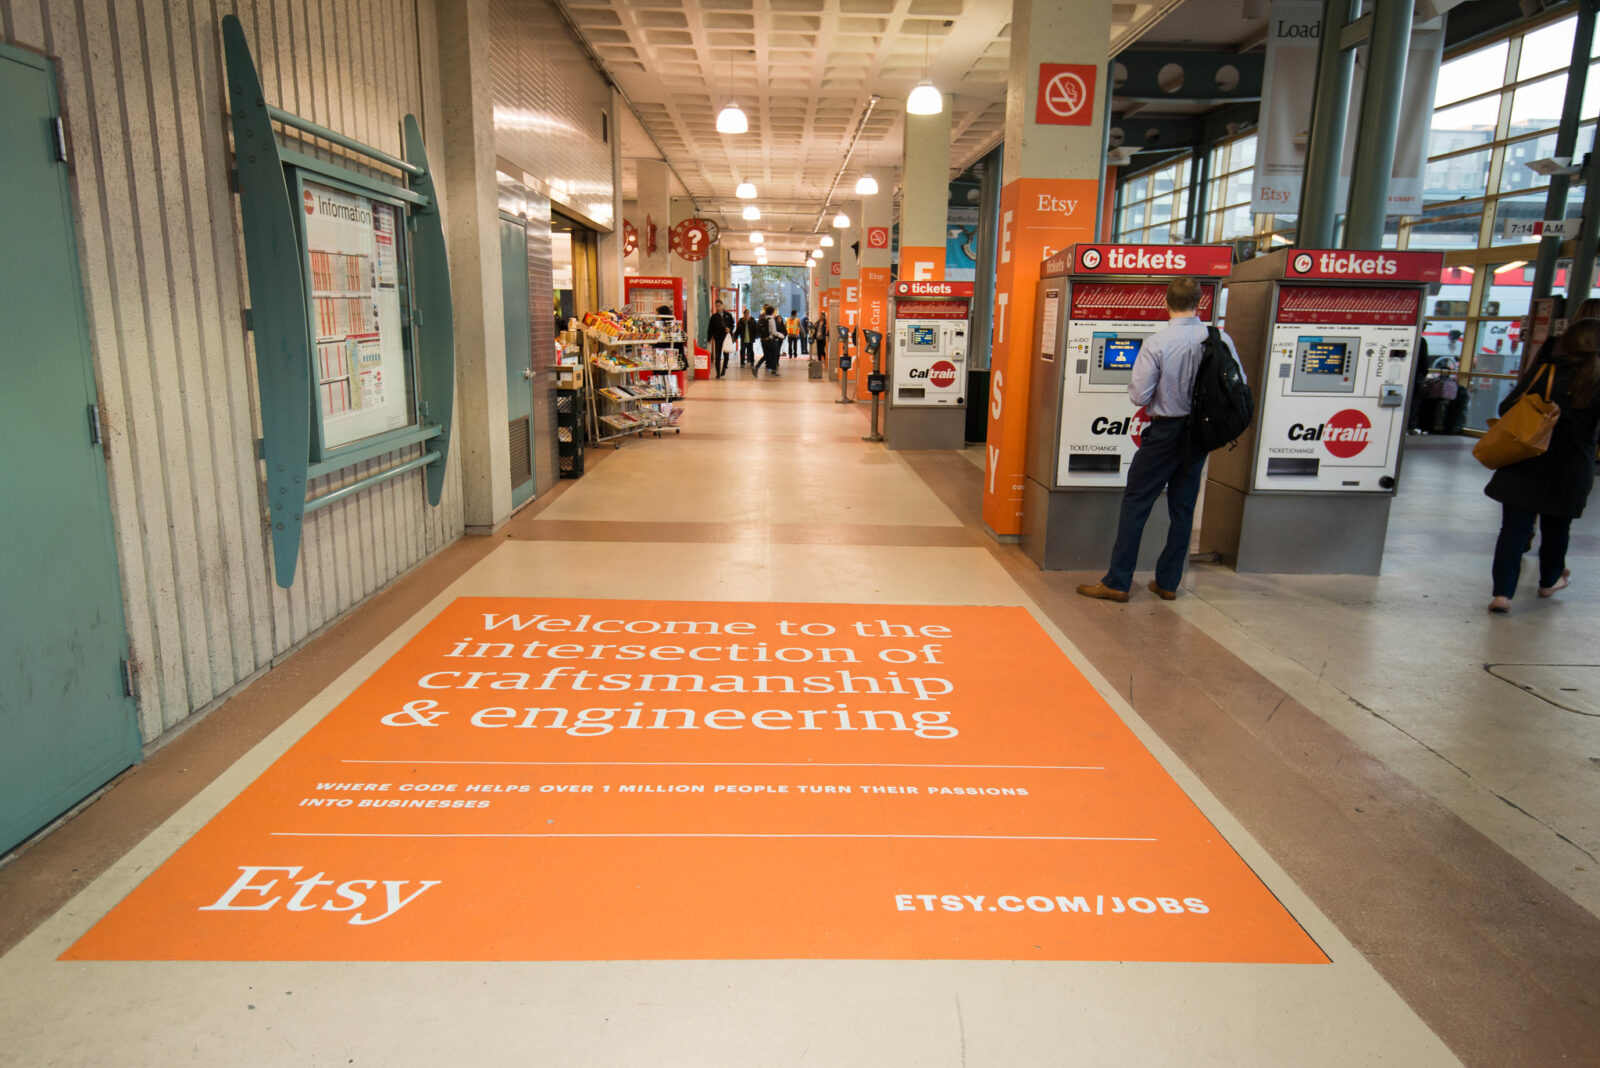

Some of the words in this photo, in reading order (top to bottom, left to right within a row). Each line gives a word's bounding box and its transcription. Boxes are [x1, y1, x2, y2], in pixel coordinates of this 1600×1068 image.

[1276, 20, 1321, 38] Load
[1036, 194, 1079, 216] Etsy
[1260, 185, 1292, 204] Etsy
[318, 195, 371, 225] Information
[1511, 224, 1533, 233] 7:14
[1544, 224, 1566, 233] A.M.
[1107, 249, 1187, 270] tickets
[1319, 253, 1397, 275] tickets
[911, 283, 952, 294] tickets
[870, 300, 881, 325] Craft
[1376, 344, 1388, 377] money
[909, 368, 957, 379] Caltrain
[1091, 416, 1152, 435] Caltr
[1287, 423, 1372, 443] Caltrain
[482, 613, 756, 635] Welcome
[775, 620, 836, 637] to
[851, 620, 953, 639] the
[443, 637, 861, 663] intersection
[878, 643, 949, 664] of
[417, 666, 954, 702] craftsmanship
[380, 699, 449, 727] &
[470, 701, 959, 740] engineering
[316, 782, 391, 791] WHERE
[399, 783, 458, 792] CODE
[466, 784, 531, 793] HELPS
[539, 785, 594, 793] OVER
[602, 785, 610, 793] 1
[619, 785, 705, 793] MILLION
[714, 785, 789, 793] PEOPLE
[798, 785, 852, 794] TURN
[860, 786, 919, 794] THEIR
[927, 787, 1029, 796] PASSIONS
[299, 798, 353, 808] INTO
[358, 799, 490, 809] BUSINESSES
[198, 865, 442, 926] Etsy
[894, 894, 1211, 916] ETSY.COM/JOBS
